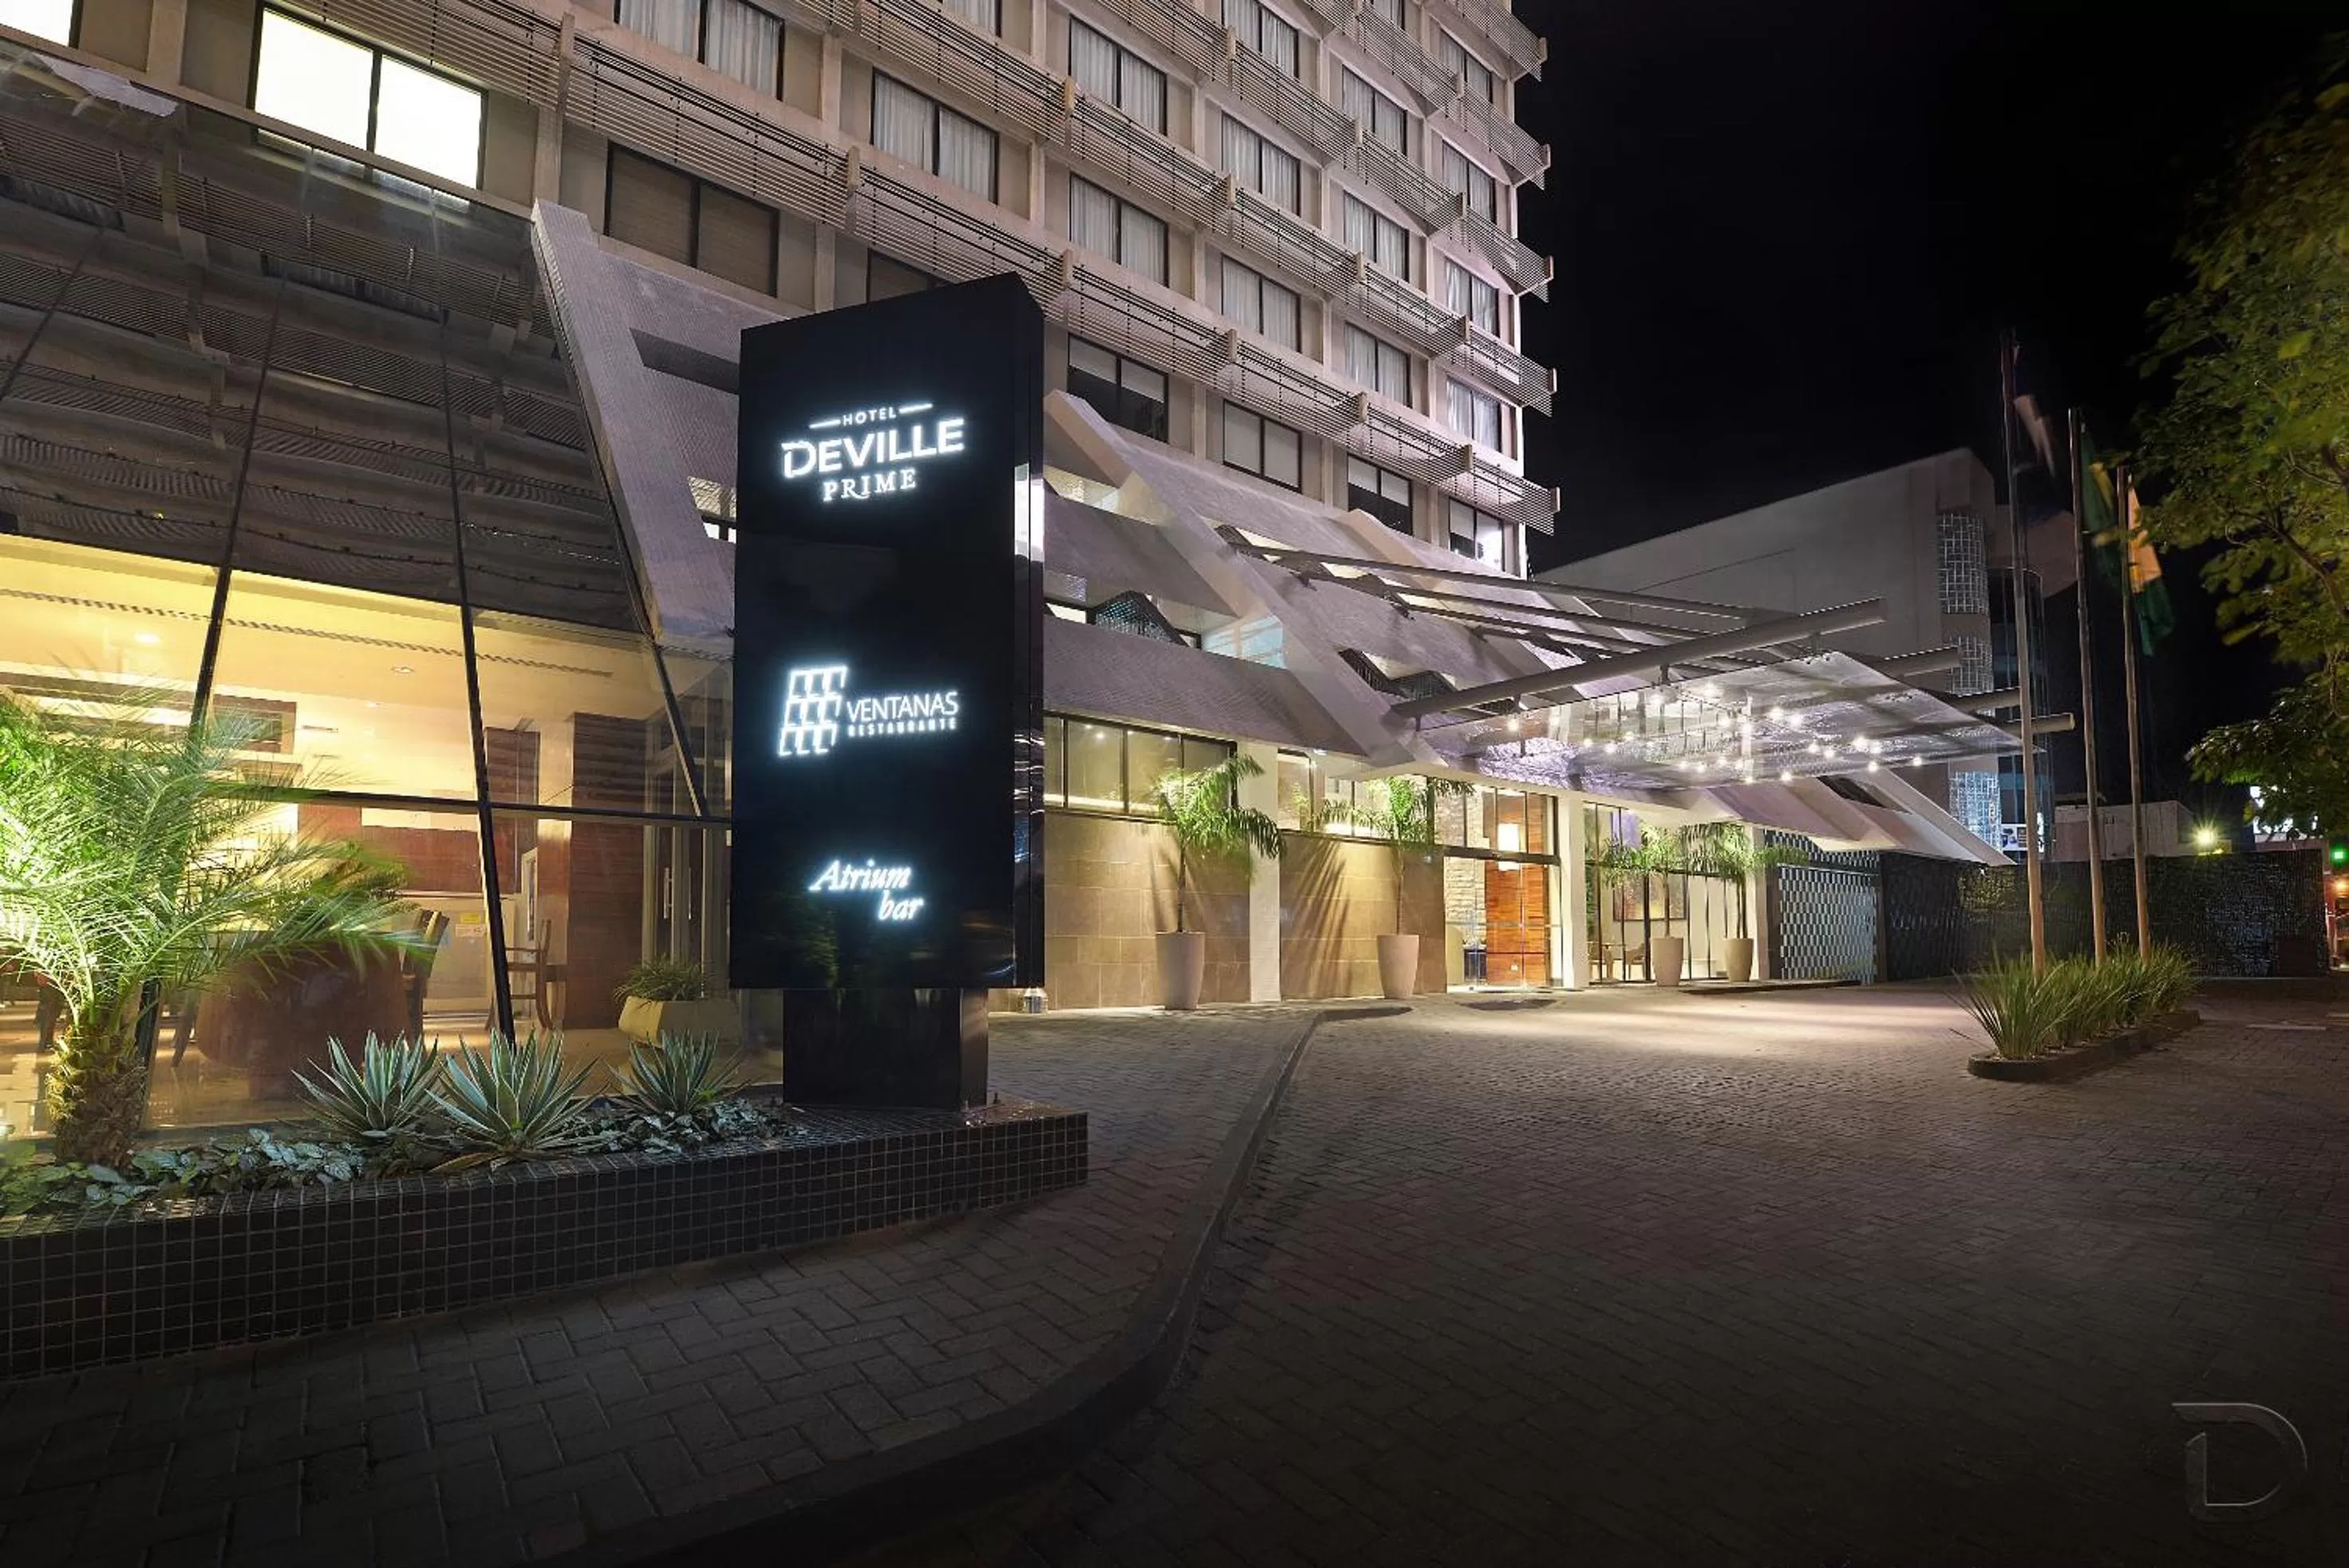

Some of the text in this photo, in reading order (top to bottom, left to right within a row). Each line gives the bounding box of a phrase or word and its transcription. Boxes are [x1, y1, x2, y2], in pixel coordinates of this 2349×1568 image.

[842, 406, 897, 426] HOTEL
[780, 418, 965, 479] DEVILLE
[822, 468, 918, 503] PRIME
[846, 690, 959, 723] VENTANAS
[807, 859, 913, 891] Atrium
[878, 889, 924, 921] bar
